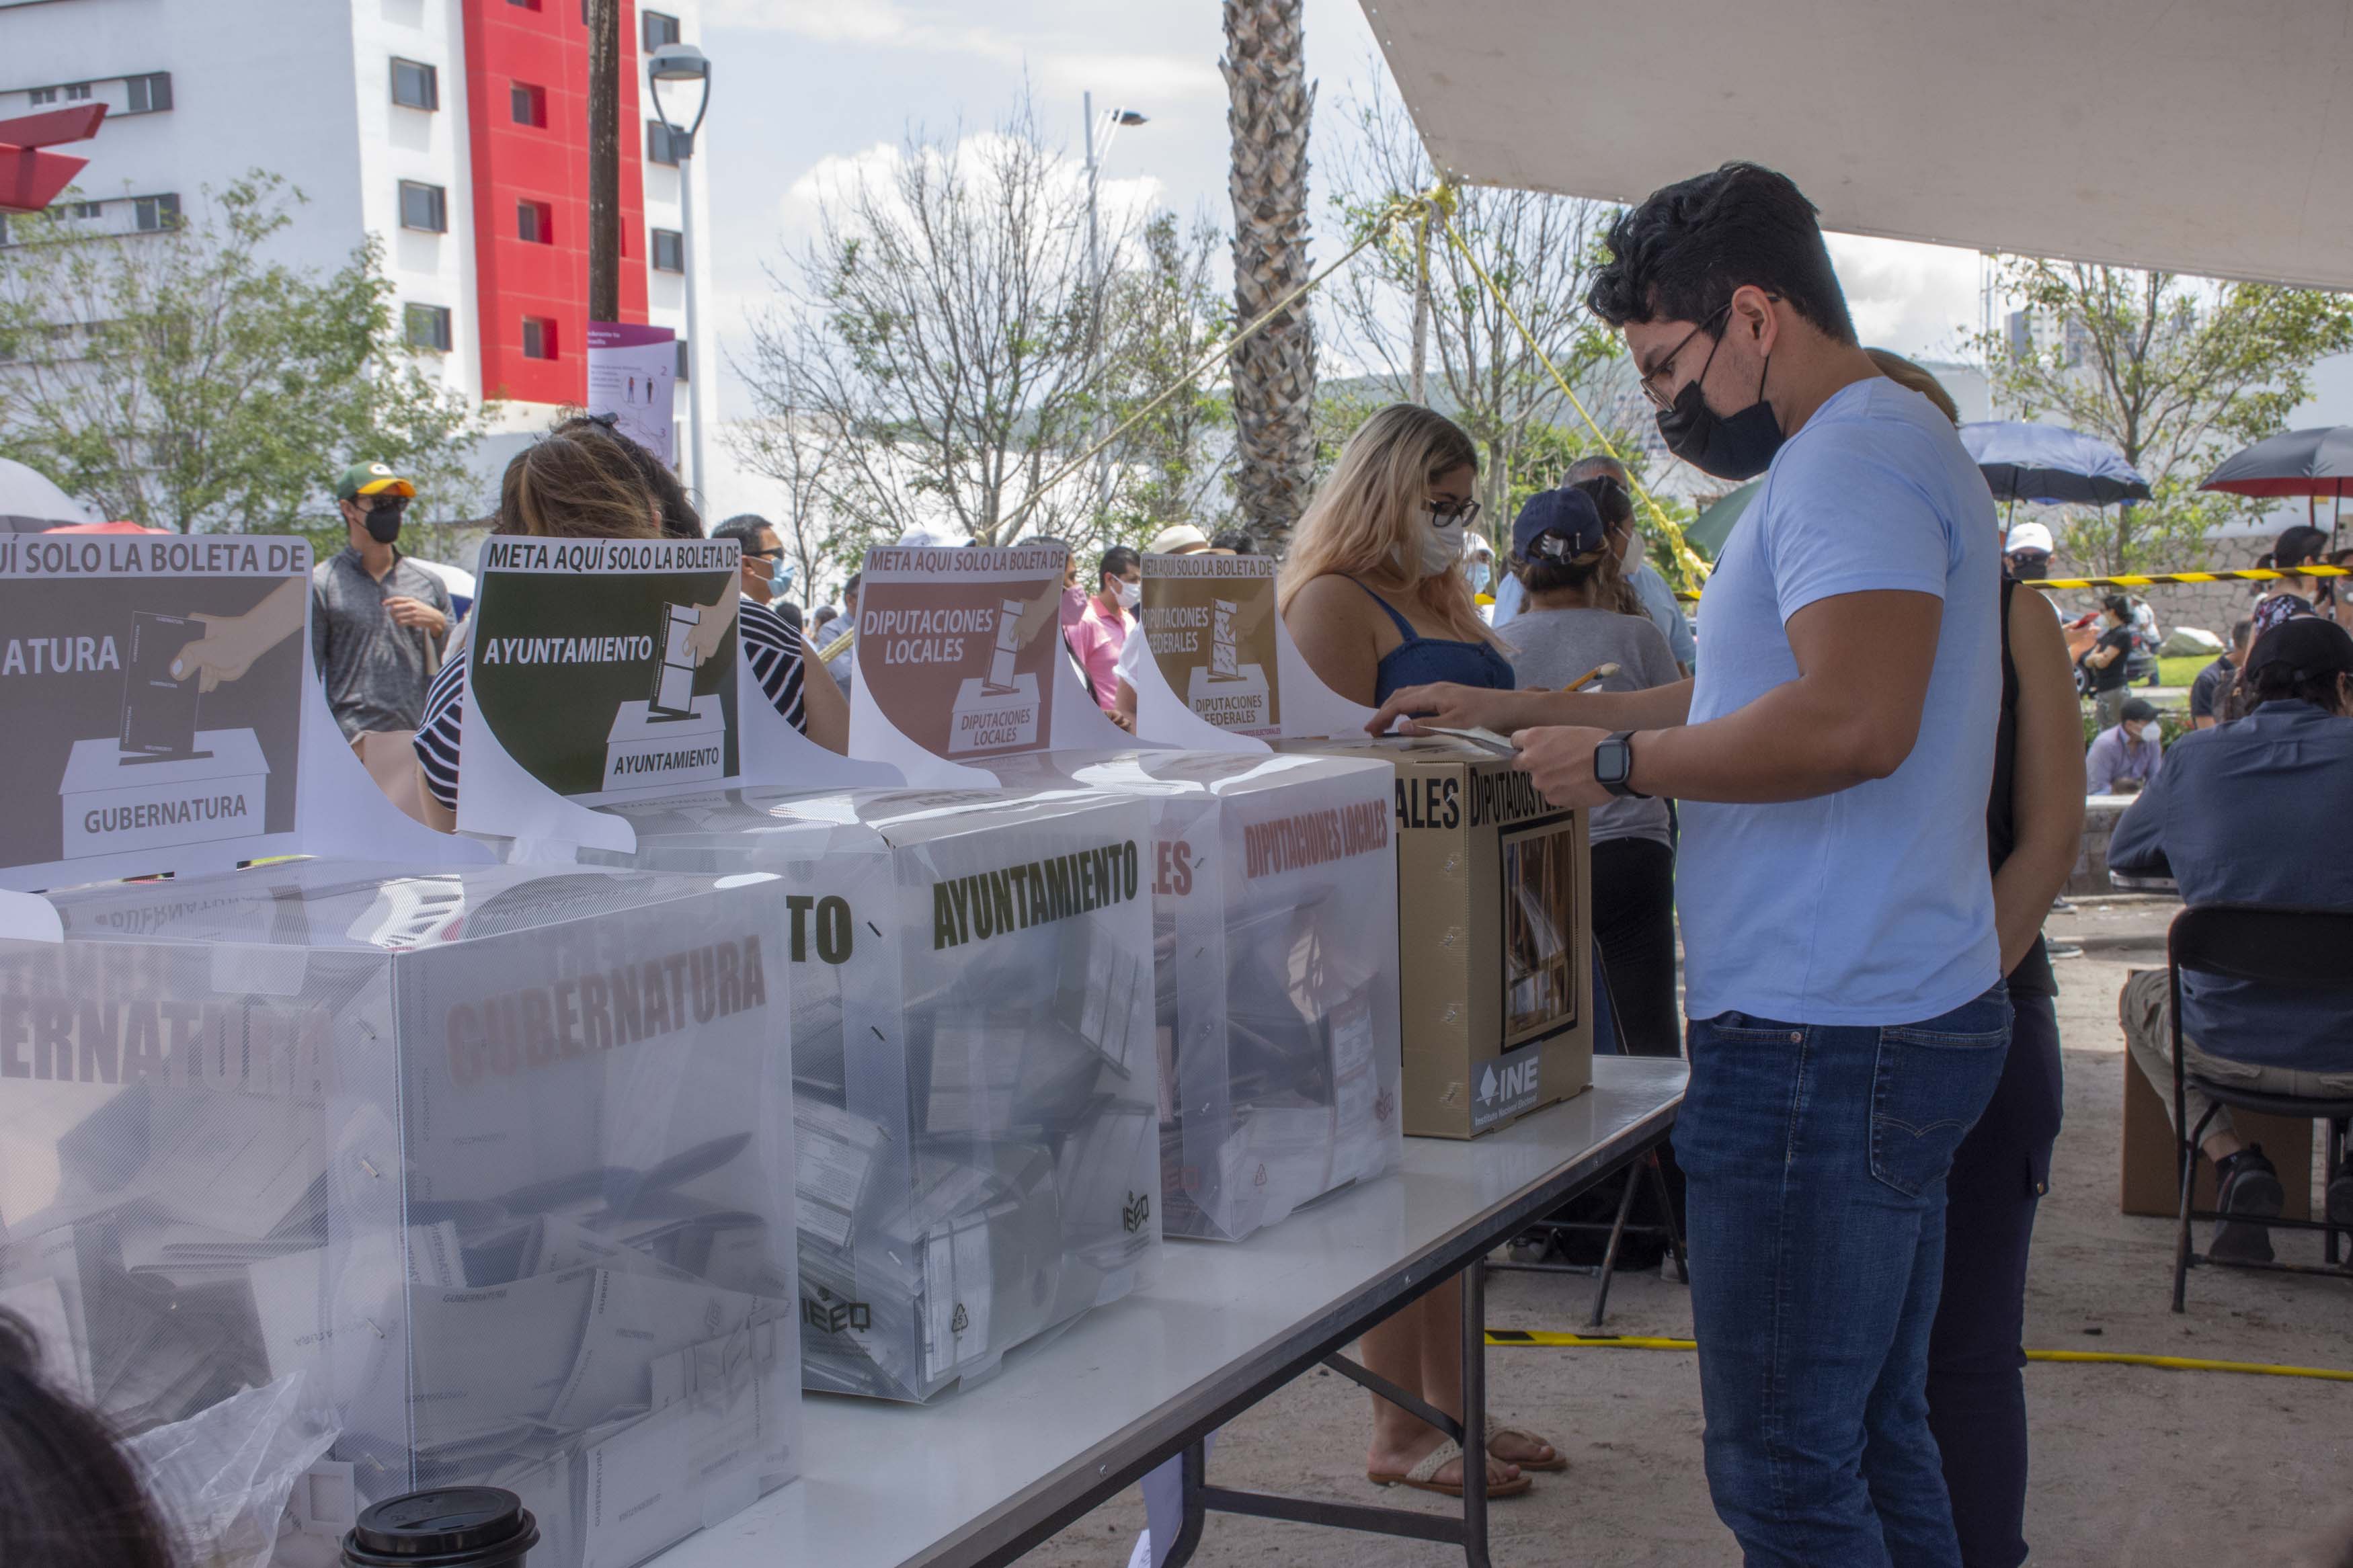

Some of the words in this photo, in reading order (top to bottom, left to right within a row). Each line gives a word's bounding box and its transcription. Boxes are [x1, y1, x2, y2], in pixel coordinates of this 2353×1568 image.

[661, 365, 668, 376] 2
[26, 543, 101, 573] SOLO
[110, 543, 143, 573] LA
[151, 543, 260, 573] BOLETA
[268, 544, 305, 572] DE
[487, 543, 548, 569] META
[553, 540, 607, 573] AQUÍ
[608, 546, 651, 570] SOLO
[655, 547, 673, 570] LA
[676, 546, 723, 569] BOLETA
[726, 546, 739, 568] DE
[869, 551, 910, 571] META
[954, 552, 991, 571] SOLO
[993, 552, 1007, 571] LA
[1010, 551, 1048, 571] BOLETA
[1049, 550, 1064, 569] DE
[1142, 559, 1158, 576] META
[1176, 559, 1200, 576] SOLO
[1202, 560, 1214, 576] LA
[1216, 560, 1257, 576] BOLETA
[1259, 560, 1273, 576] DE
[864, 608, 994, 635] DIPUTACIONES
[1143, 607, 1209, 630] DIPUTACIONES
[2, 636, 120, 675] ATURA
[483, 635, 653, 665] AYUNTAMIENTO
[885, 638, 964, 665] LOCALES
[1195, 694, 1262, 712] DIPUTACIONES
[961, 708, 1031, 731] DIPUTACIONES
[974, 727, 1016, 746] LOCALES
[614, 747, 719, 775] AYUNTAMIENTO
[1395, 778, 1460, 829] ALES
[1470, 766, 1536, 827] DIPUTADOS
[84, 794, 247, 834] GUBERNATURA
[1244, 808, 1341, 879] DIPUTACIONES
[1341, 798, 1388, 857] LOCALES
[933, 839, 1138, 950] AYUNTAMIENTO
[786, 895, 853, 965] TO
[446, 935, 766, 1087] GUBERNATURA
[1500, 1056, 1539, 1103] INE
[1475, 1112, 1498, 1126] Instituto
